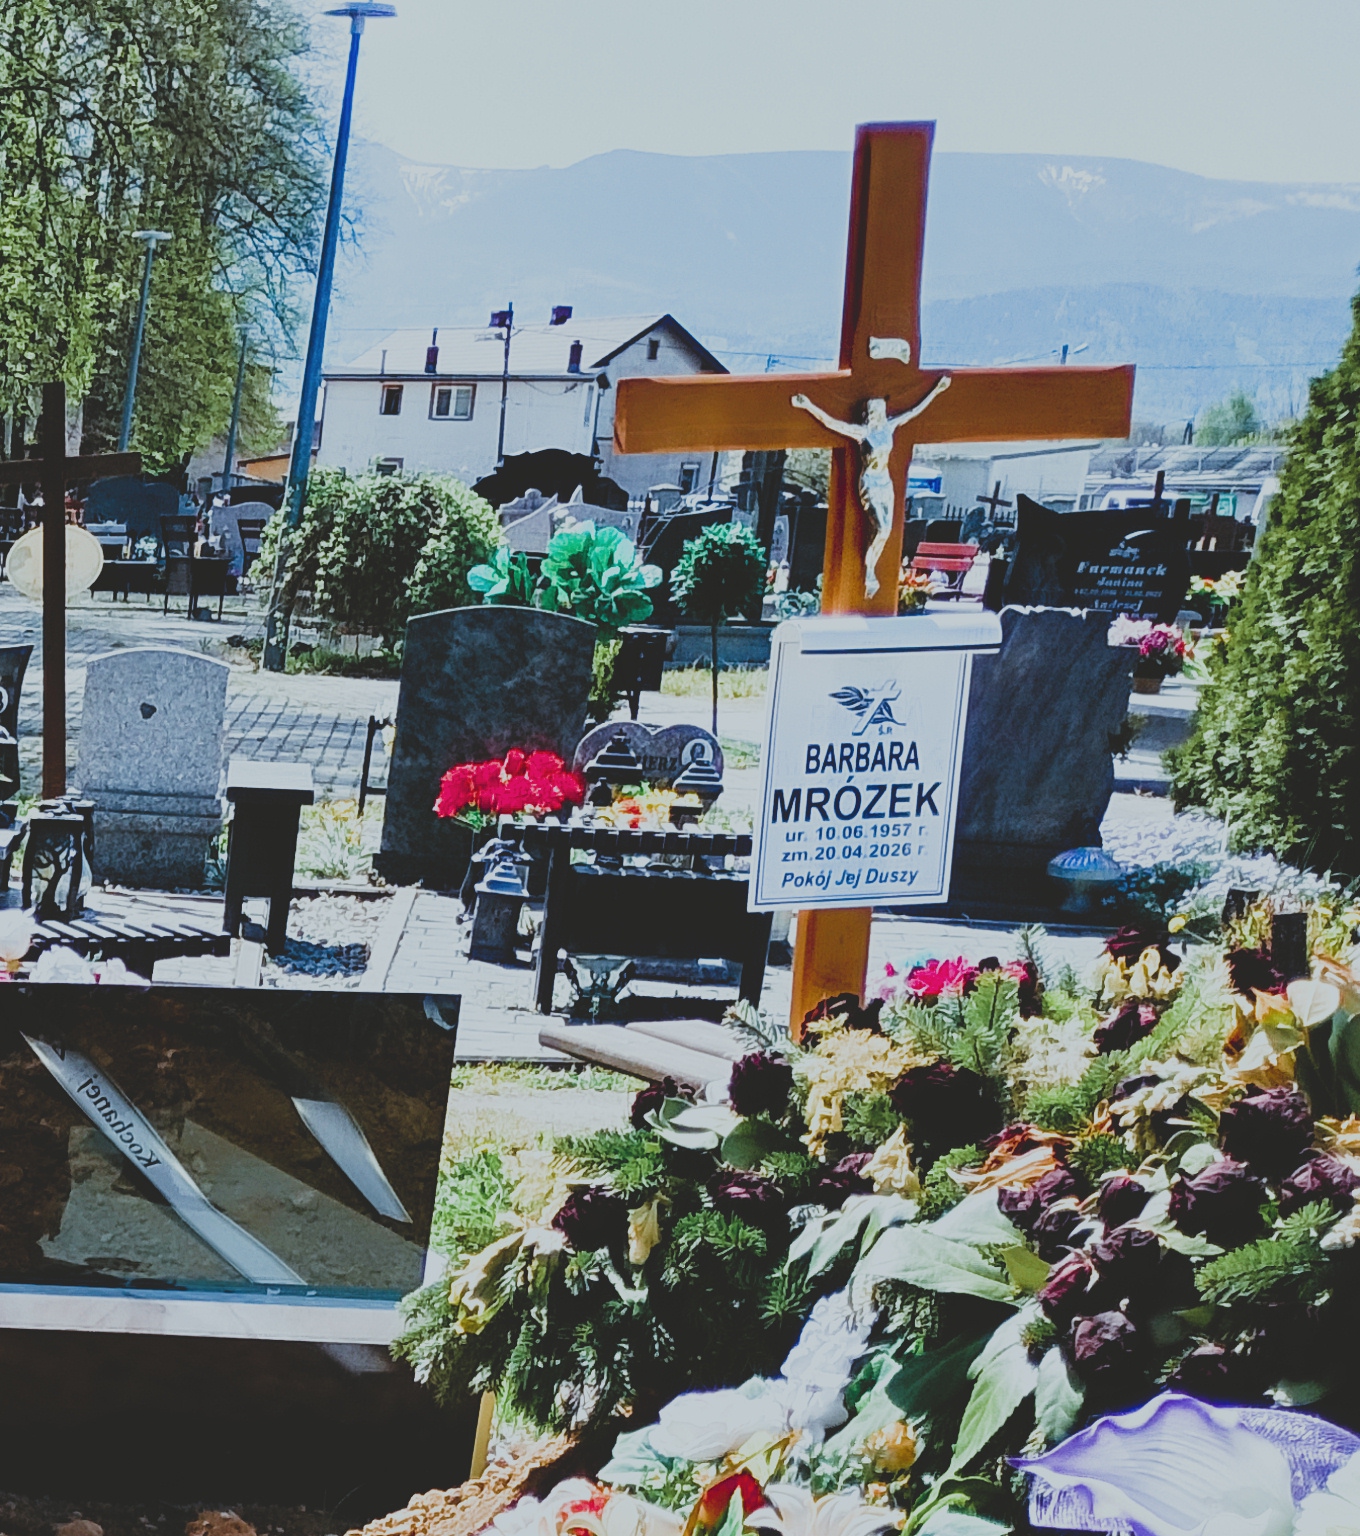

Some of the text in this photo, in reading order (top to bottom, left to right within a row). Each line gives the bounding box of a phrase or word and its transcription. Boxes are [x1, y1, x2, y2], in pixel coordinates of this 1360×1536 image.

[805, 740, 920, 774] BARBARA
[772, 775, 942, 824] MRÓZEK
[816, 823, 912, 841] 10.06.1957
[781, 867, 919, 891] Pokój Jej Duszy
